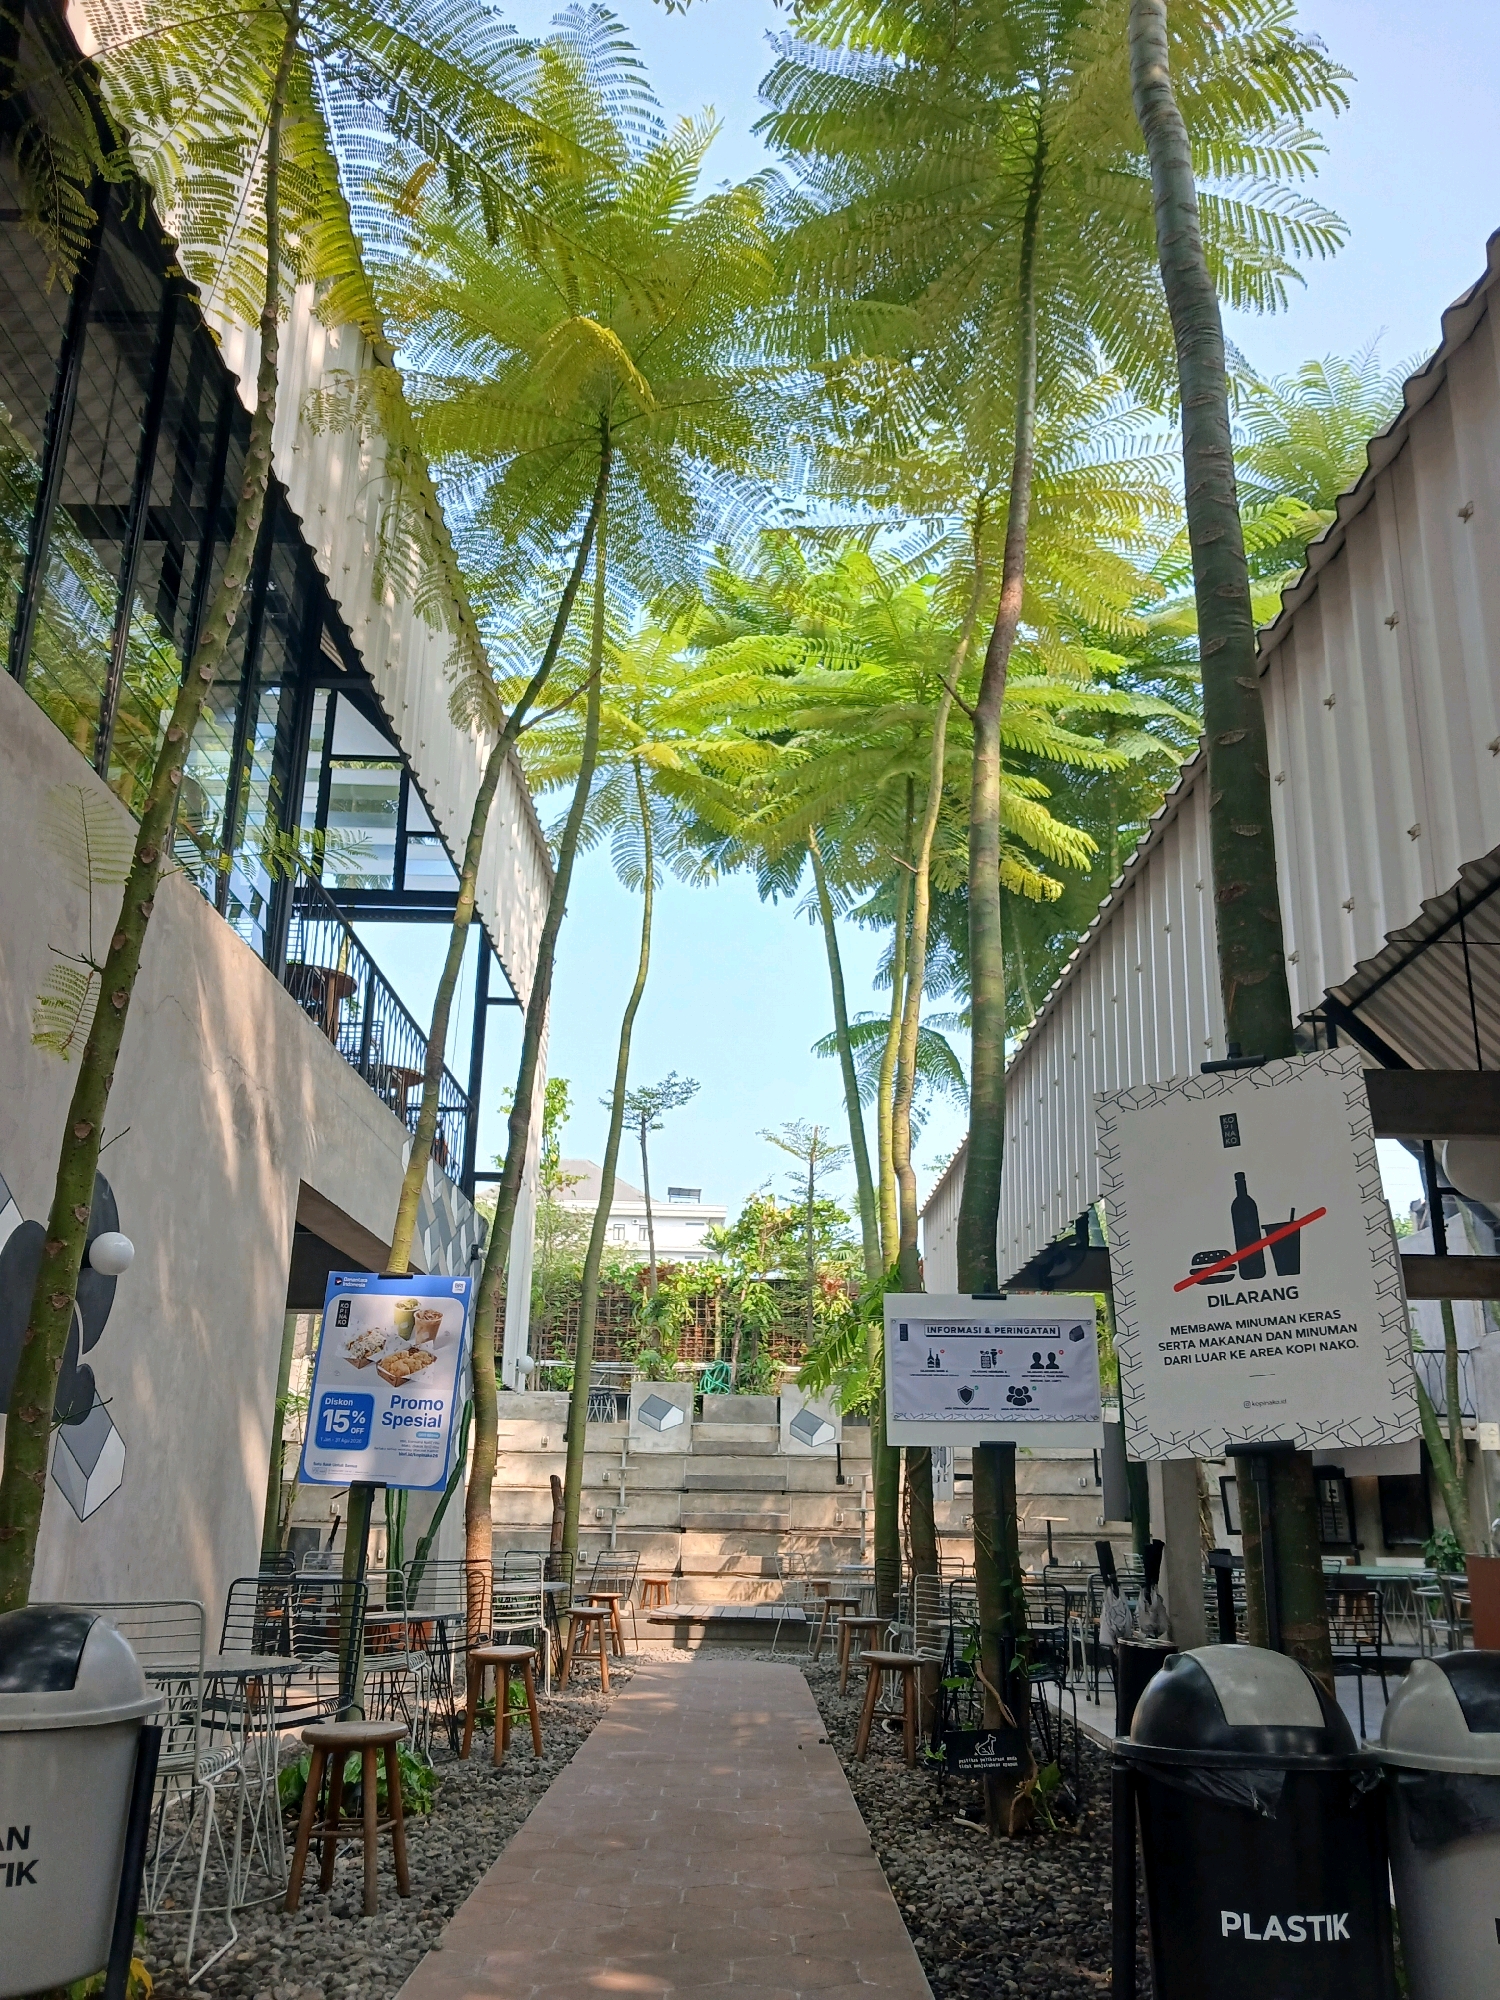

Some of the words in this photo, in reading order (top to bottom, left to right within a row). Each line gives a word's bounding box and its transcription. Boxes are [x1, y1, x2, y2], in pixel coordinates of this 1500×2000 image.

[1223, 1116, 1234, 1124] KO
[1207, 1286, 1299, 1308] DILARANG
[927, 1326, 982, 1334] INFORMASI
[994, 1327, 1056, 1335] PERINGATAN
[1170, 1321, 1232, 1336] MEMBAWA
[1236, 1314, 1296, 1329] MINUMAN
[1299, 1310, 1341, 1322] KERAS
[1158, 1340, 1196, 1351] SERTA
[1199, 1333, 1262, 1348] MAKANAN
[1266, 1330, 1292, 1342] DAN
[1296, 1324, 1358, 1338] MINUMAN
[1164, 1355, 1192, 1366] DARI
[1195, 1351, 1226, 1363] LUAR
[1230, 1350, 1246, 1360] KE
[1250, 1347, 1283, 1358] AREA
[1286, 1343, 1316, 1355] KOPI
[1319, 1339, 1359, 1351] NAKO.
[325, 1398, 353, 1406] Diskon
[390, 1395, 444, 1411] Promo
[381, 1411, 442, 1429] Spesial
[1220, 1910, 1350, 1942] PLASTIK
